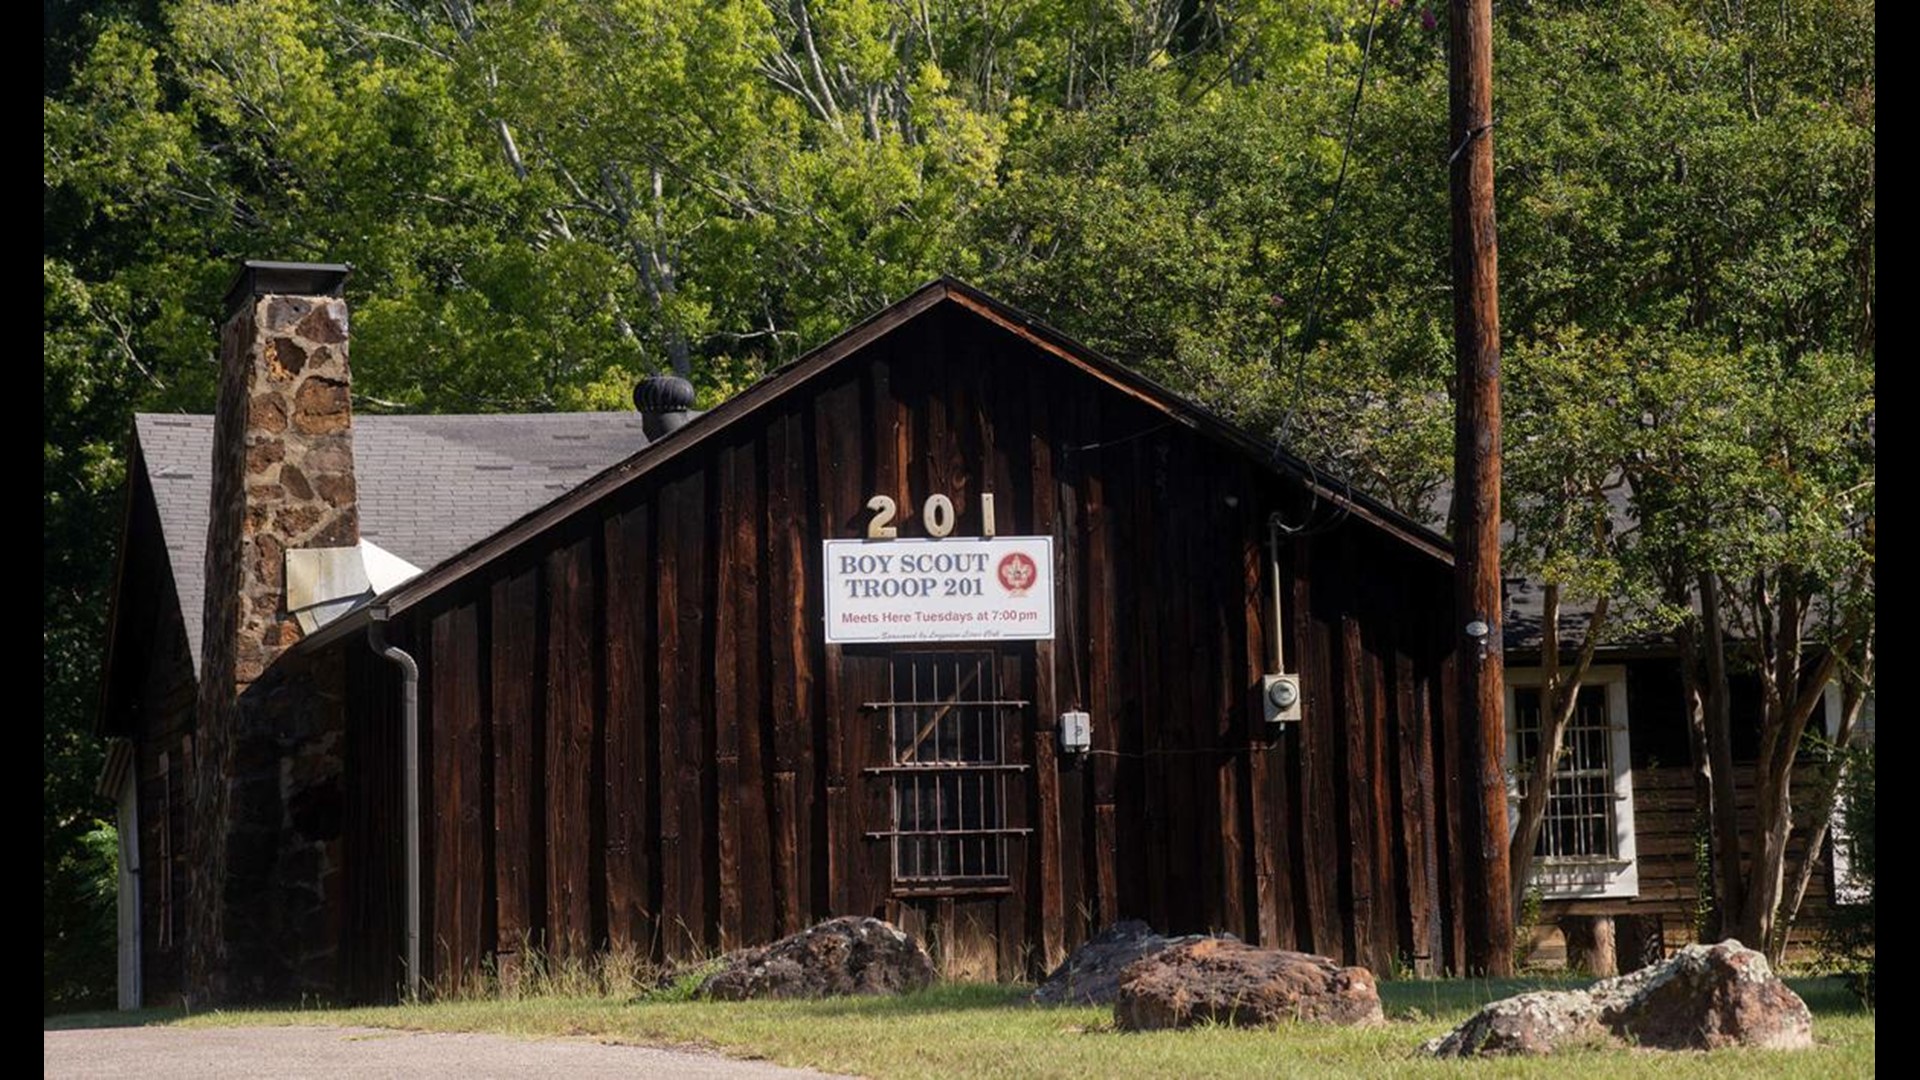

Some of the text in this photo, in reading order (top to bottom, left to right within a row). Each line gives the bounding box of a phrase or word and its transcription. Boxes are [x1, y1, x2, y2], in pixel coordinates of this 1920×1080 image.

[866, 493, 995, 538] 201
[839, 553, 989, 574] BOY SCOUT
[845, 576, 984, 598] TROOP 201
[842, 610, 1037, 624] Meets Here Tuesdays at 7:00 pm
